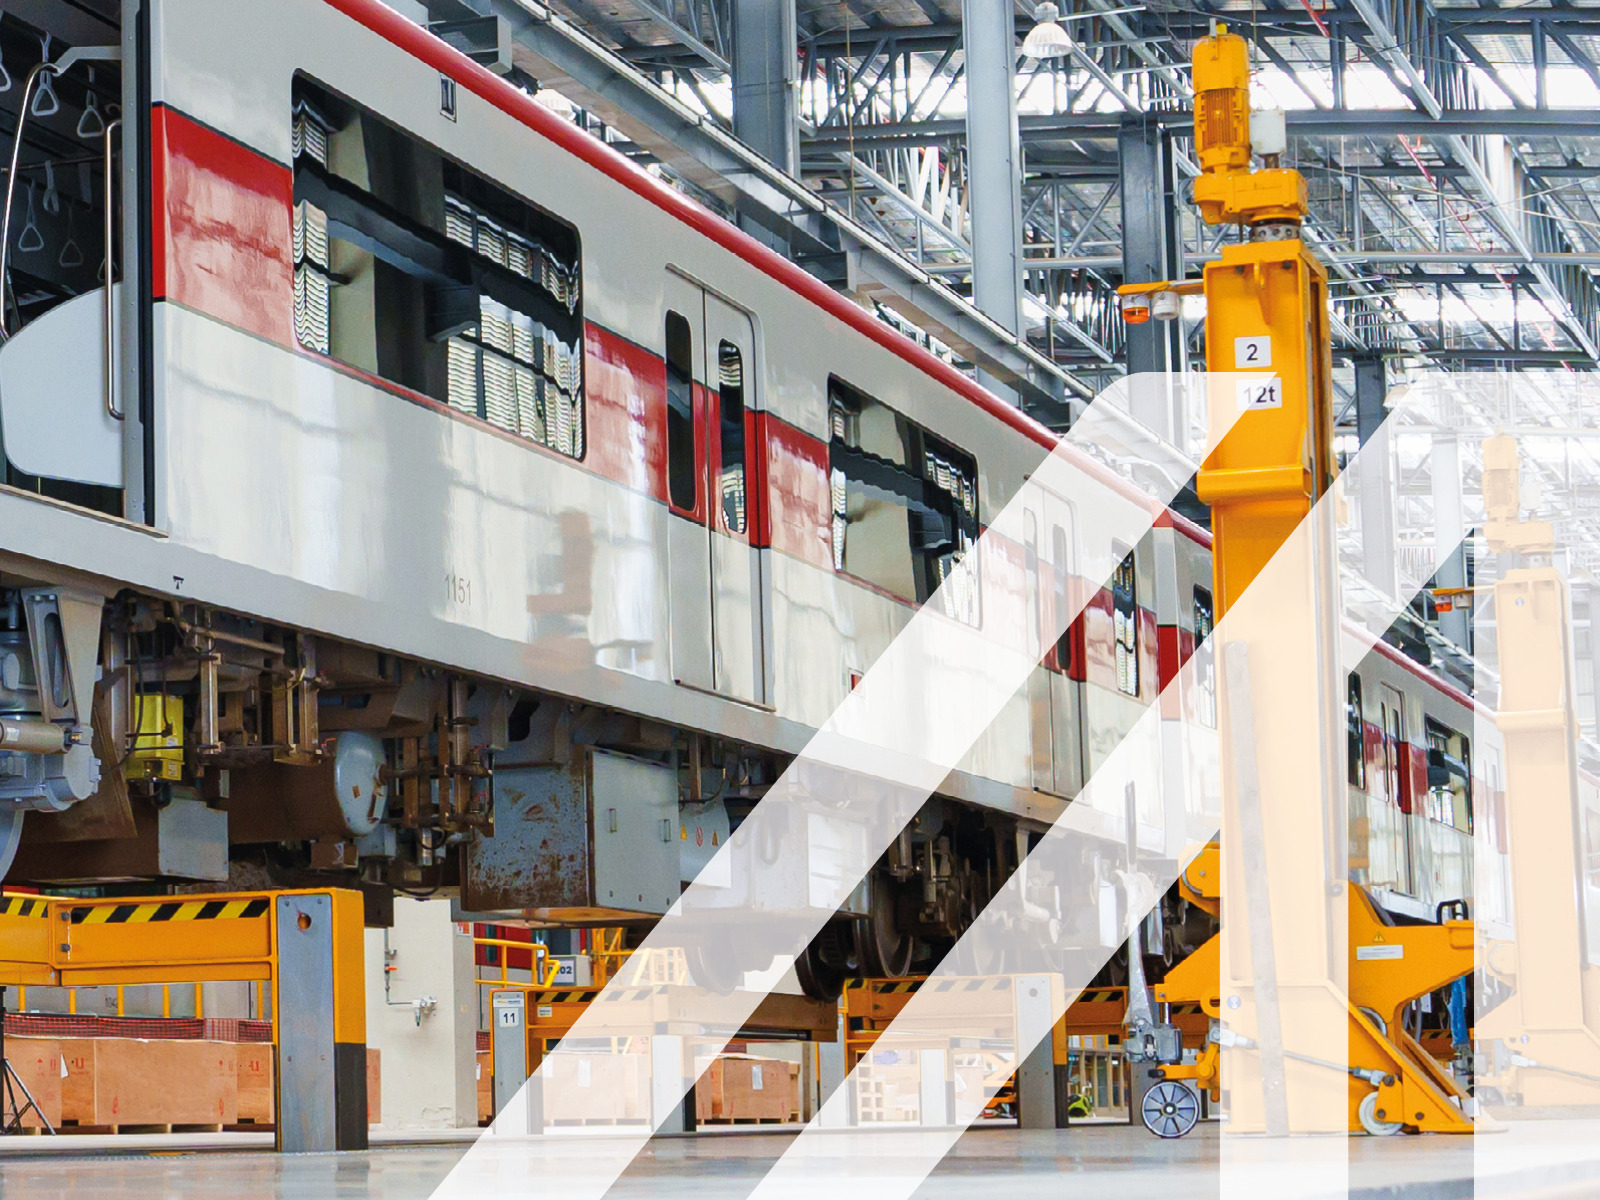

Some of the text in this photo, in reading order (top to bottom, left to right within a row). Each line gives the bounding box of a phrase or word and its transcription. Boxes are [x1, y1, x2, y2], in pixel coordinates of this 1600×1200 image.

[1246, 343, 1258, 361] 2
[1243, 386, 1276, 403] 12t
[444, 573, 472, 606] 1151
[503, 1012, 516, 1024] 11
